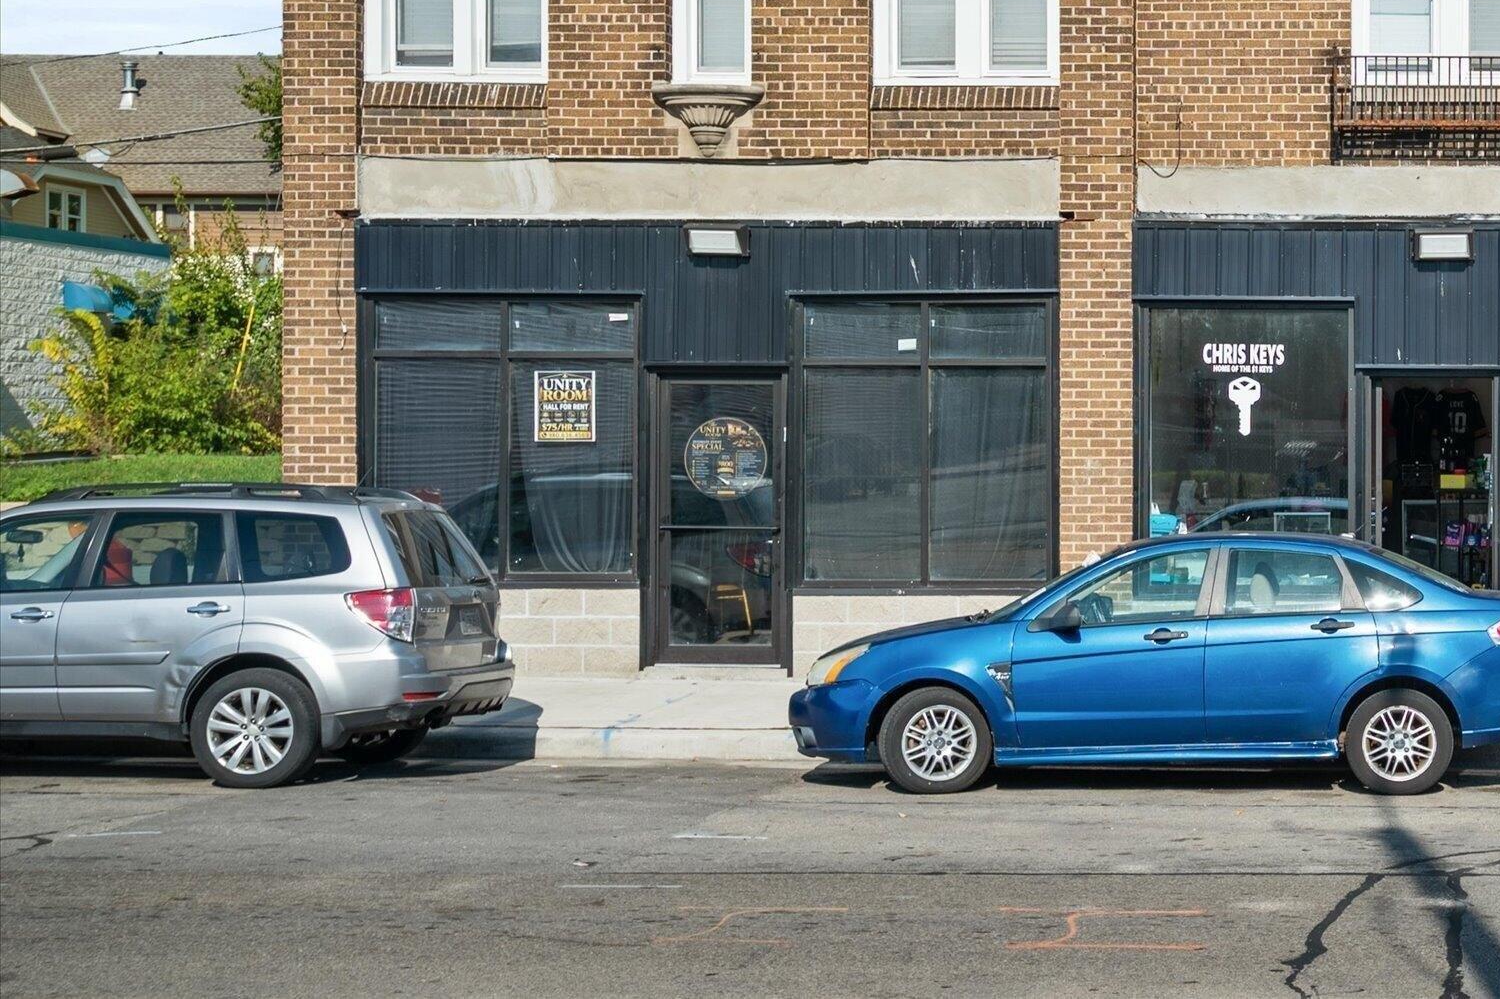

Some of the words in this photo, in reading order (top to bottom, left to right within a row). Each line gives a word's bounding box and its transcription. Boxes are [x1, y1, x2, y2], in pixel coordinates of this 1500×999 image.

[1202, 343, 1246, 364] CHRIS
[1249, 344, 1285, 365] KEYS
[1212, 365, 1230, 373] HOME
[1231, 365, 1239, 373] OF
[1240, 365, 1251, 373] THE
[1252, 365, 1258, 374] $1
[1259, 365, 1273, 374] KEYS
[542, 378, 589, 390] UNITY
[543, 390, 588, 401] ROOM
[699, 426, 726, 434] UNITY
